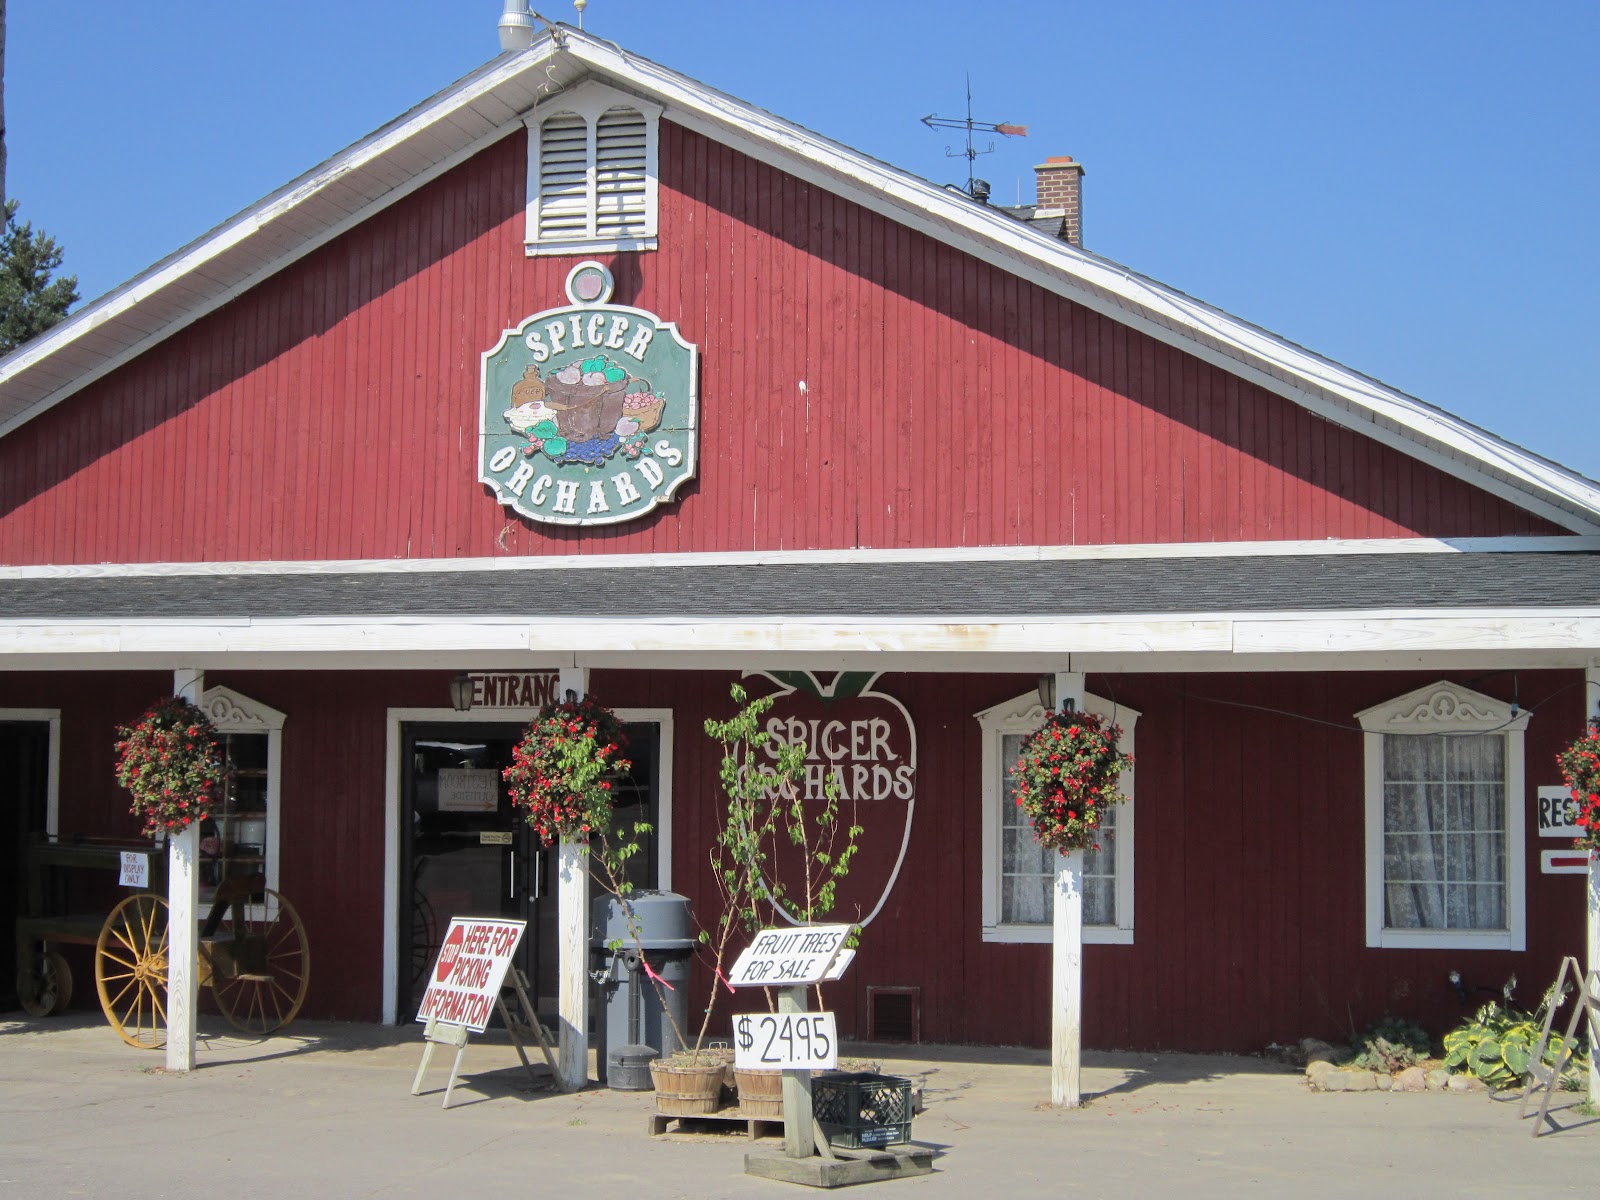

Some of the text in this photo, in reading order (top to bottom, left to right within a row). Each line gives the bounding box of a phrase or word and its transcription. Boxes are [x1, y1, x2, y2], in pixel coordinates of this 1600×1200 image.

[525, 313, 653, 362] SPICER
[489, 440, 683, 514] ORCHARDS
[472, 674, 560, 706] ENTRANC
[763, 716, 898, 761] SPICER
[1539, 797, 1580, 828] RES
[123, 864, 144, 874] DISPLAY
[126, 854, 137, 863] FOR
[125, 875, 139, 884] ONLY
[440, 925, 518, 963] STOP HERE FOR
[752, 932, 842, 955] FRUIT TREES
[450, 957, 492, 989] PICKING
[741, 960, 774, 981] FOR
[773, 959, 815, 979] SALE
[420, 988, 494, 1026] INFORMATION
